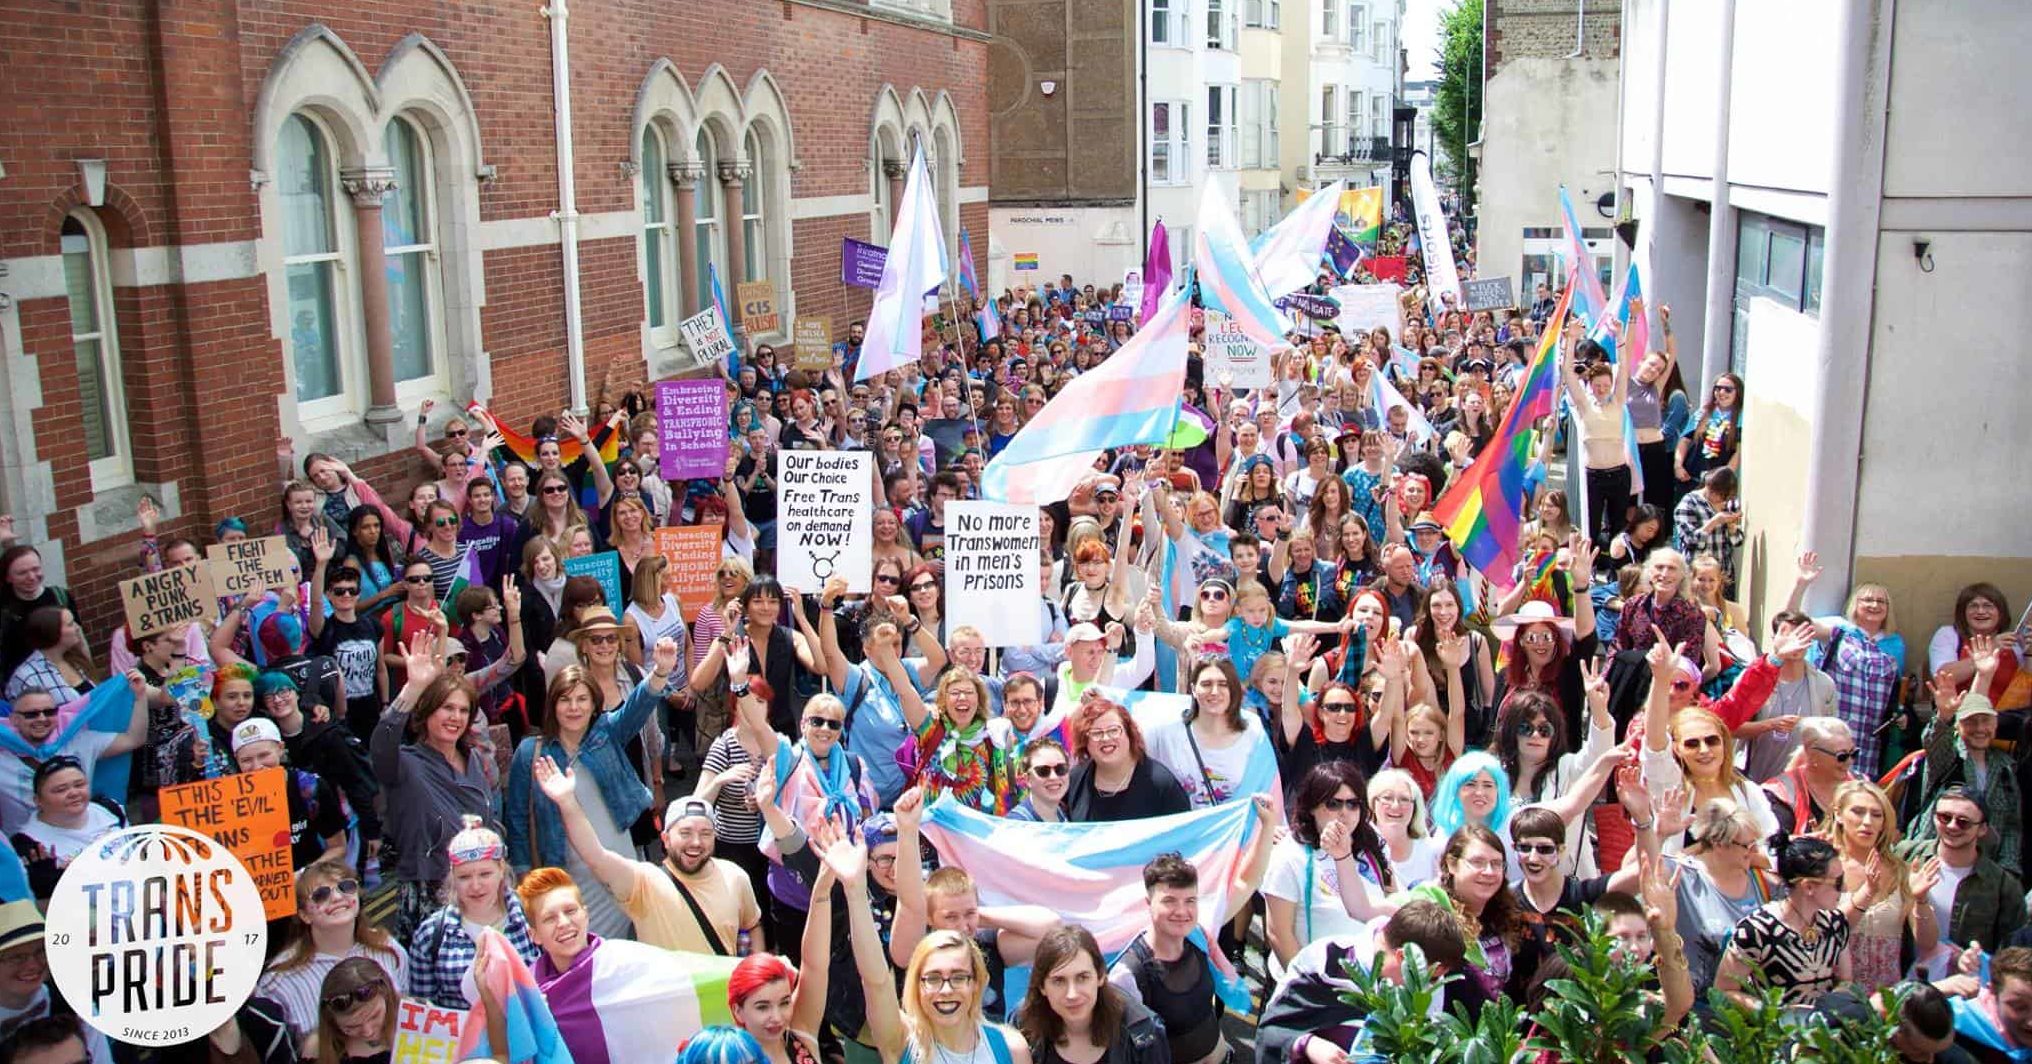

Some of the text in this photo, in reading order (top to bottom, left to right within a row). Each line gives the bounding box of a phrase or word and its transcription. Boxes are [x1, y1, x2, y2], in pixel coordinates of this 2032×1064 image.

[745, 301, 770, 315] CIS
[682, 310, 715, 337] THEY
[697, 338, 731, 363] PLURAL
[1227, 345, 1257, 356] NOW
[662, 386, 720, 396] Embracing
[663, 395, 721, 406] Diversity
[664, 405, 721, 416] & Ending
[664, 417, 722, 429] TRANSPHOBIC
[664, 429, 723, 441] Bullying
[665, 440, 722, 451] In Schools
[786, 455, 859, 470] Our bodies
[784, 470, 847, 484] Our Choice
[784, 489, 860, 503] Free Trans
[787, 503, 855, 518] healthcare
[786, 519, 852, 533] on demand
[958, 514, 1031, 532] No more
[661, 532, 717, 541] Embracing
[947, 533, 1039, 551] Transwomen
[227, 540, 266, 560] FIGHT
[661, 539, 717, 551] Diversity
[673, 550, 716, 560] Ending
[955, 552, 1023, 571] in men's
[235, 558, 263, 573] THE
[226, 569, 284, 590] CIS-TEM
[146, 588, 189, 610] PUNK
[140, 600, 203, 631] & TRANS
[167, 774, 255, 805] THIS IS
[174, 804, 225, 827] THE
[245, 849, 290, 871] THE
